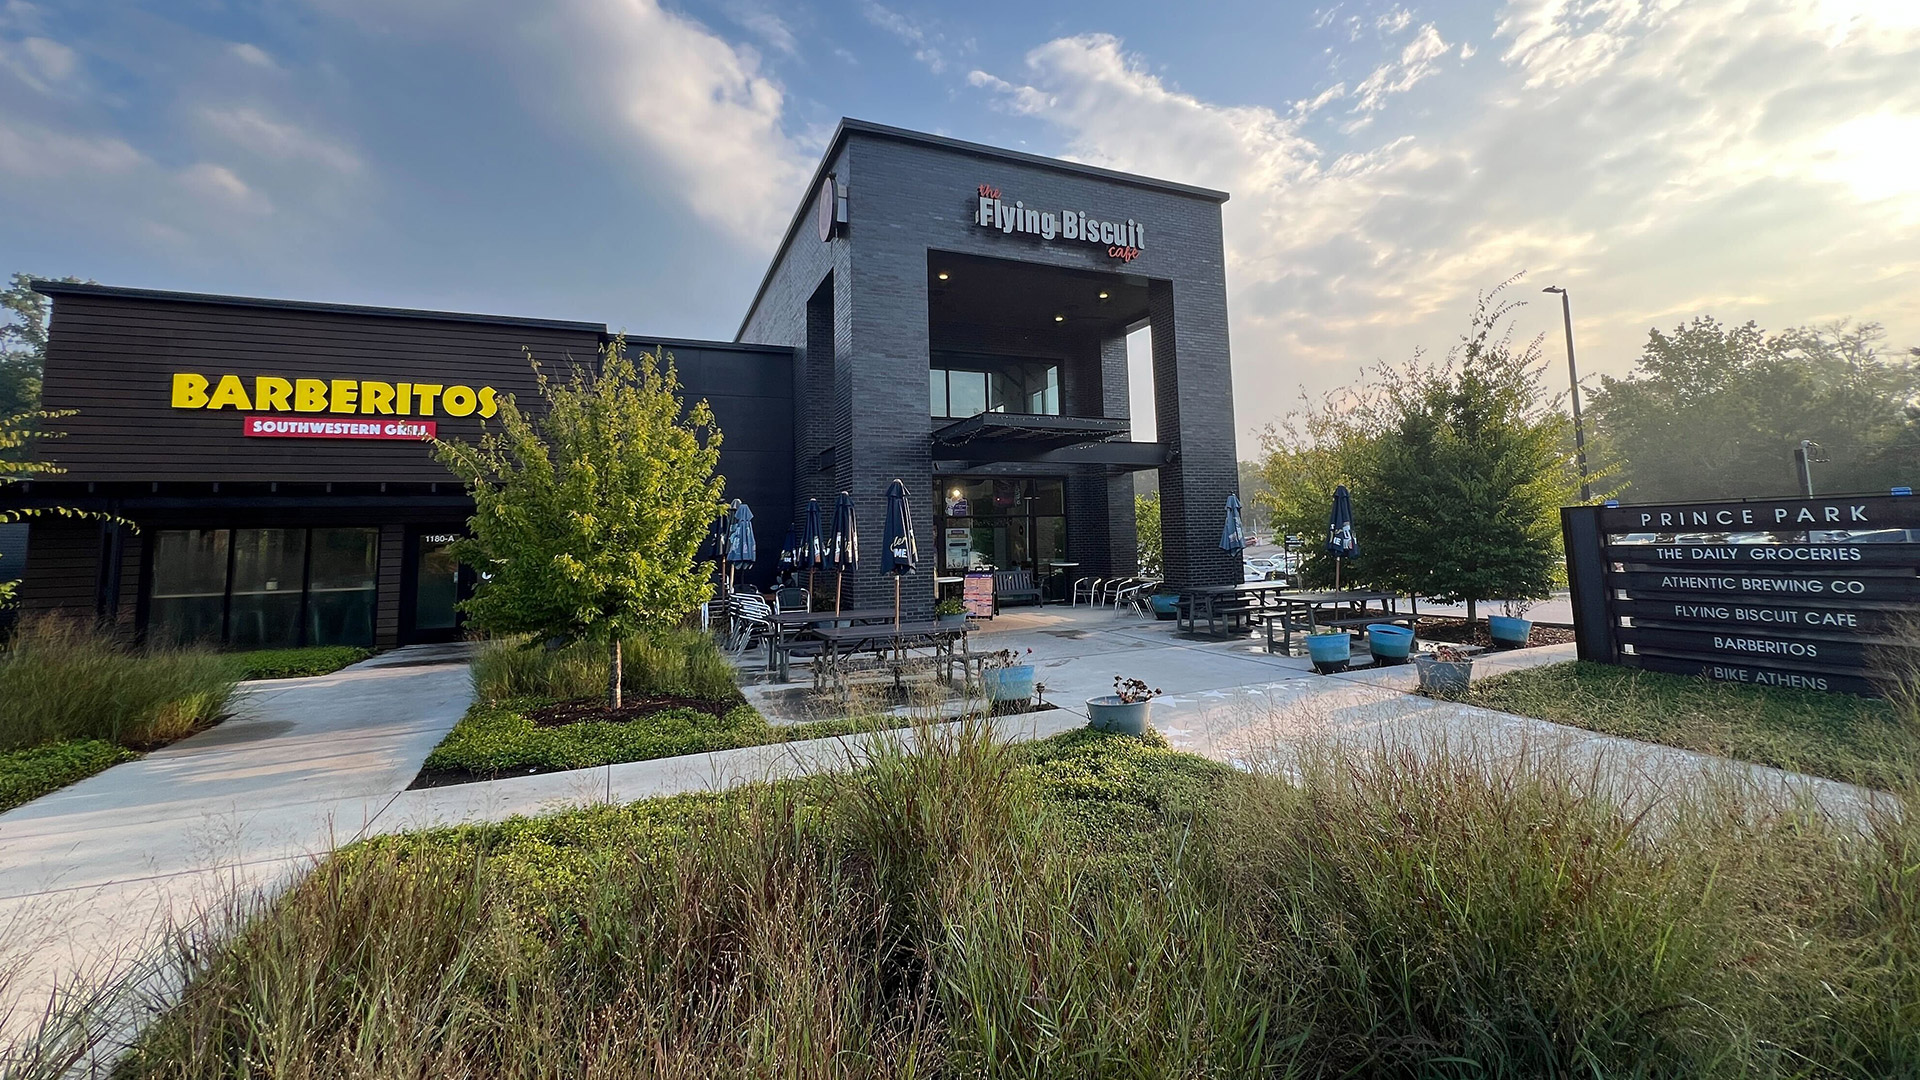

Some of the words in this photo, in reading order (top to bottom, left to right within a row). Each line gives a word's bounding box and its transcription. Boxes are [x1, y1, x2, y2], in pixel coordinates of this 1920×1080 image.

[978, 184, 1001, 198] the
[980, 197, 1055, 239] Flying
[1062, 210, 1144, 249] Biscuit
[1108, 246, 1139, 262] cafe
[171, 373, 498, 419] BARBERITOS
[253, 420, 381, 435] SOUTHWESTERN
[1641, 510, 1753, 527] PRINCE
[1775, 505, 1868, 524] PARK
[1656, 548, 1683, 560] THE
[1692, 548, 1738, 560] DAILY
[1750, 548, 1862, 561] GROCERIES
[1661, 576, 1736, 590] ATHENTIC
[1742, 579, 1824, 593] BREWING
[1831, 580, 1865, 594] CO
[1674, 605, 1730, 620] FLYING
[1735, 608, 1798, 623] BISCUIT
[1805, 611, 1857, 627] CAFE
[1714, 637, 1817, 657] BARBERITOS
[1714, 666, 1749, 682] BIKE
[1755, 673, 1828, 691] ATHENS
